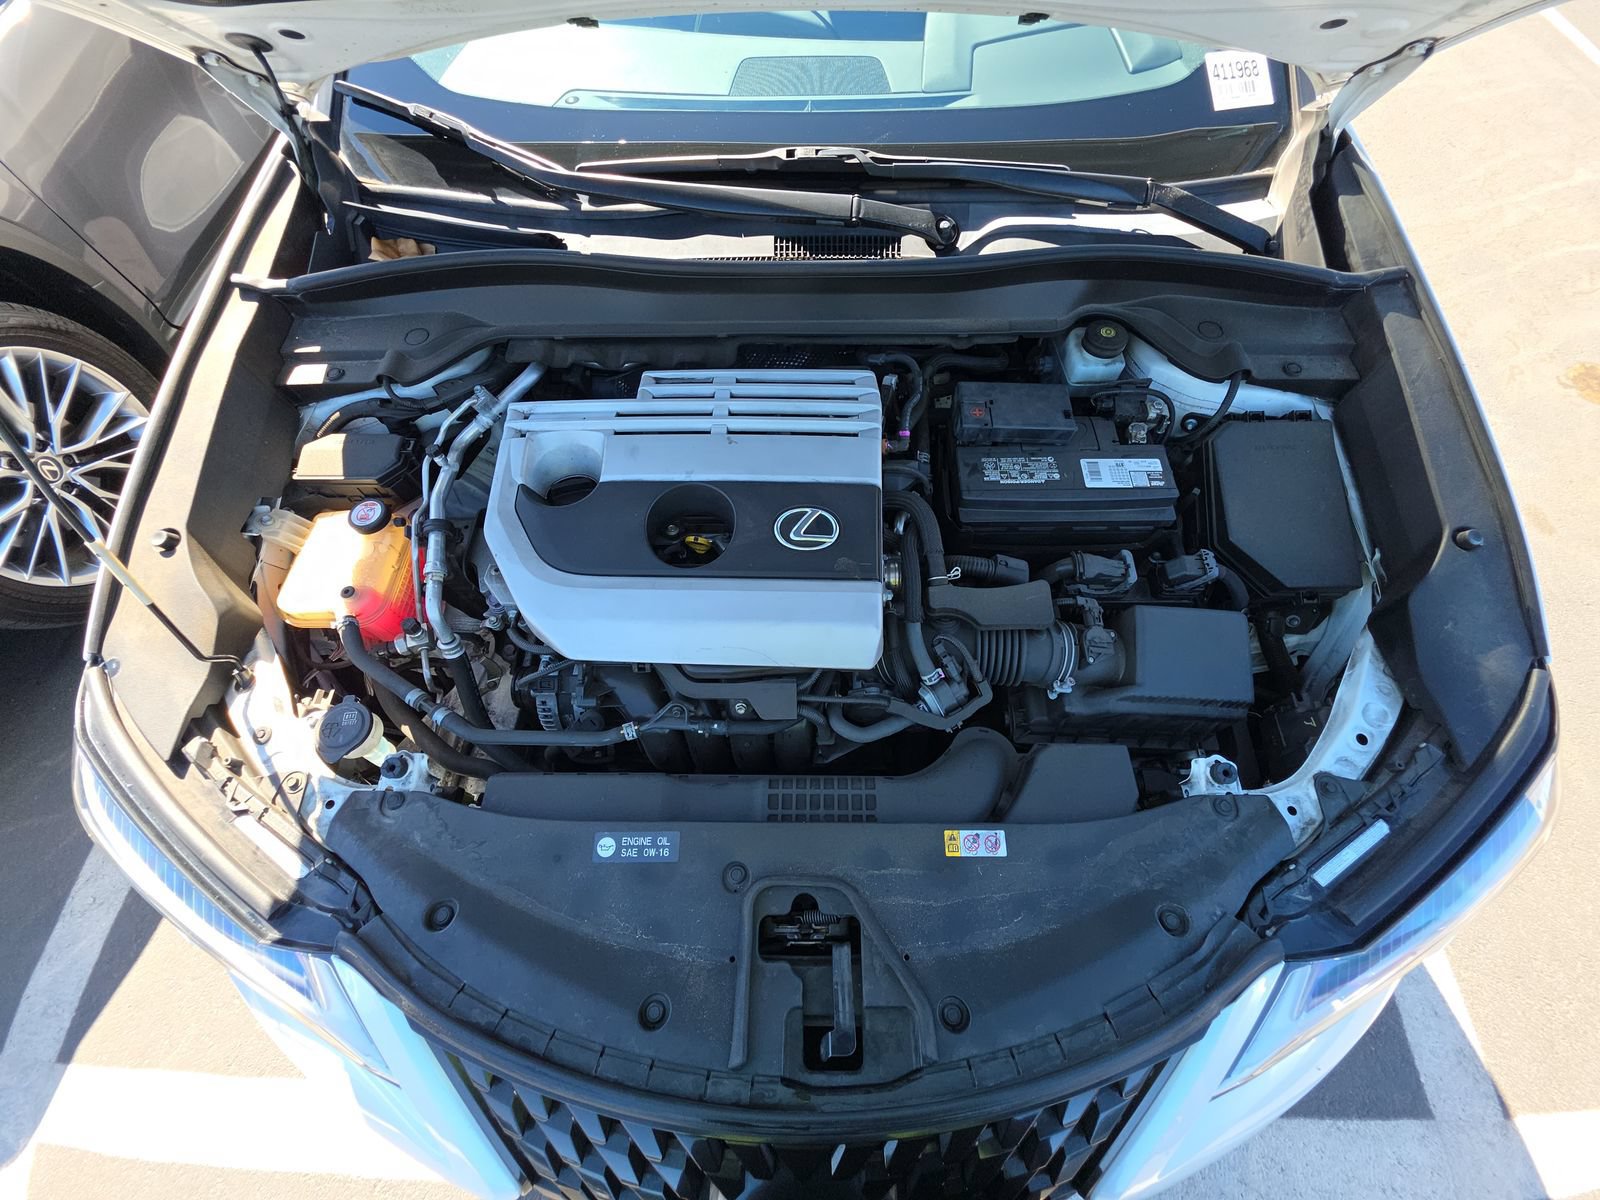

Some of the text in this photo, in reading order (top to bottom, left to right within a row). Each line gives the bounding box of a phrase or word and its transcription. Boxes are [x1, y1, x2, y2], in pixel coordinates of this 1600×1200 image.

[1213, 60, 1260, 80] 411968
[621, 836, 671, 846] ENGINE OIL
[620, 848, 670, 857] SAE 0W-16
